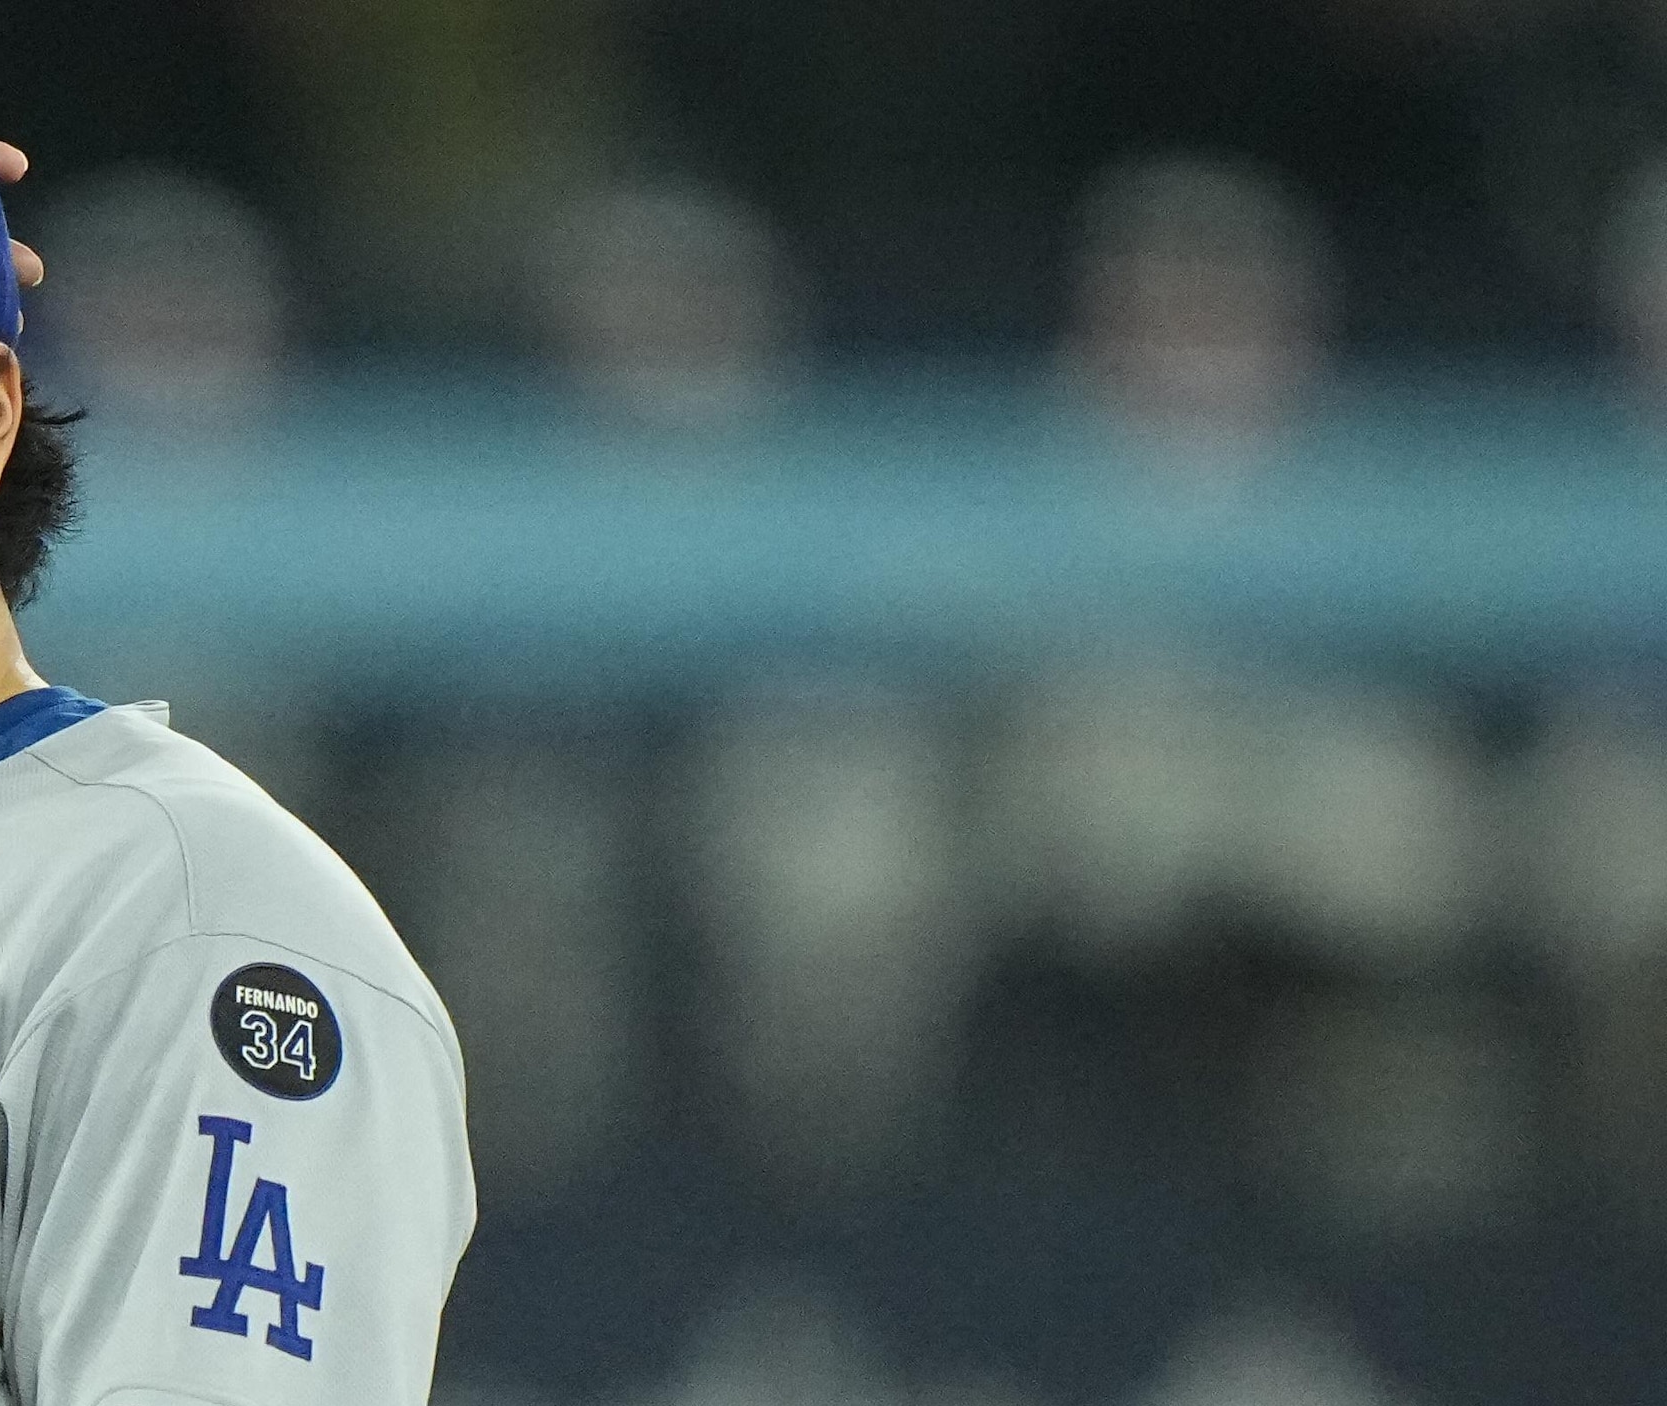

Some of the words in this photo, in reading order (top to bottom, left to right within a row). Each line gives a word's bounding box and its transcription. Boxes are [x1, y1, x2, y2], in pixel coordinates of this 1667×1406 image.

[235, 984, 319, 1019] FERNANDO
[240, 1009, 317, 1081] 34
[179, 1115, 325, 1361] LA
